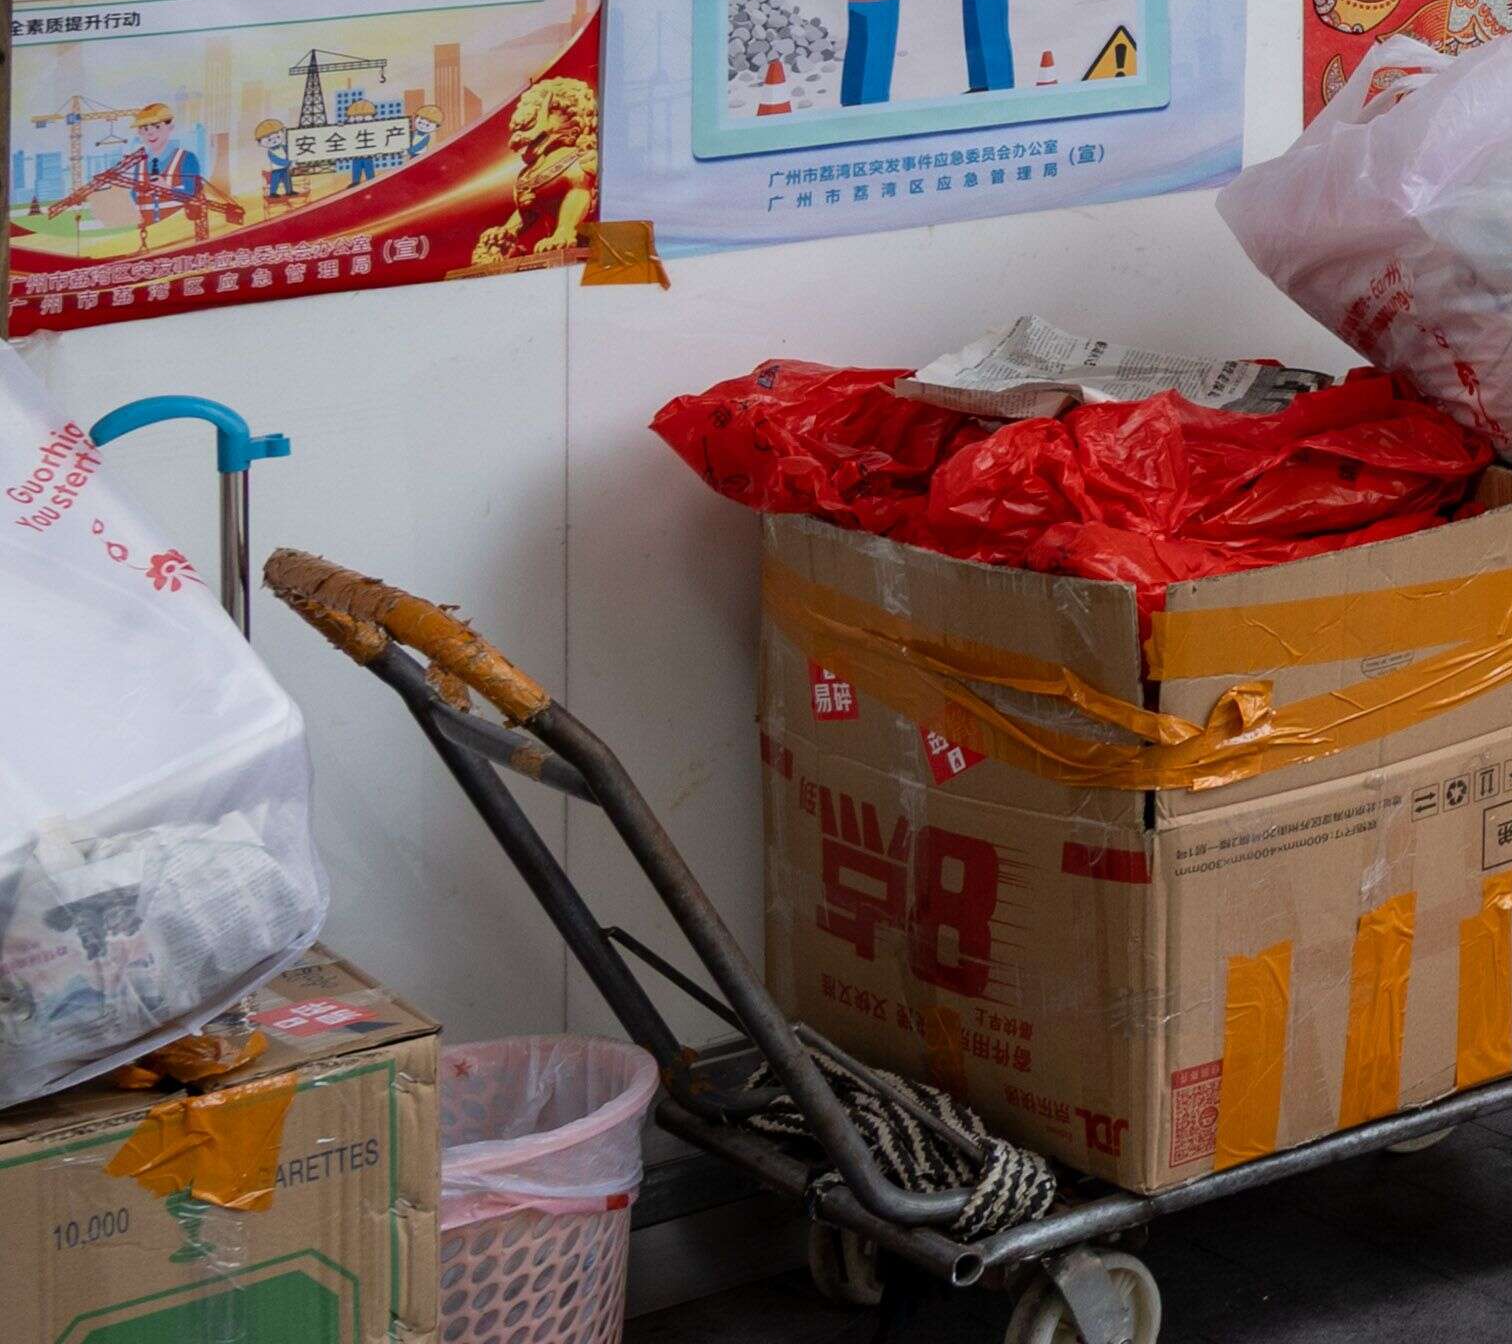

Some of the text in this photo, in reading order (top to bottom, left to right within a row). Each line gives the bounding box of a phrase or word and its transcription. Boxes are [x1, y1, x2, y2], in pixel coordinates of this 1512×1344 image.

[295, 126, 406, 157] 安全生产
[815, 683, 852, 713] 易碎
[1075, 1108, 1129, 1158] JDL
[258, 1138, 380, 1189] ARETTES
